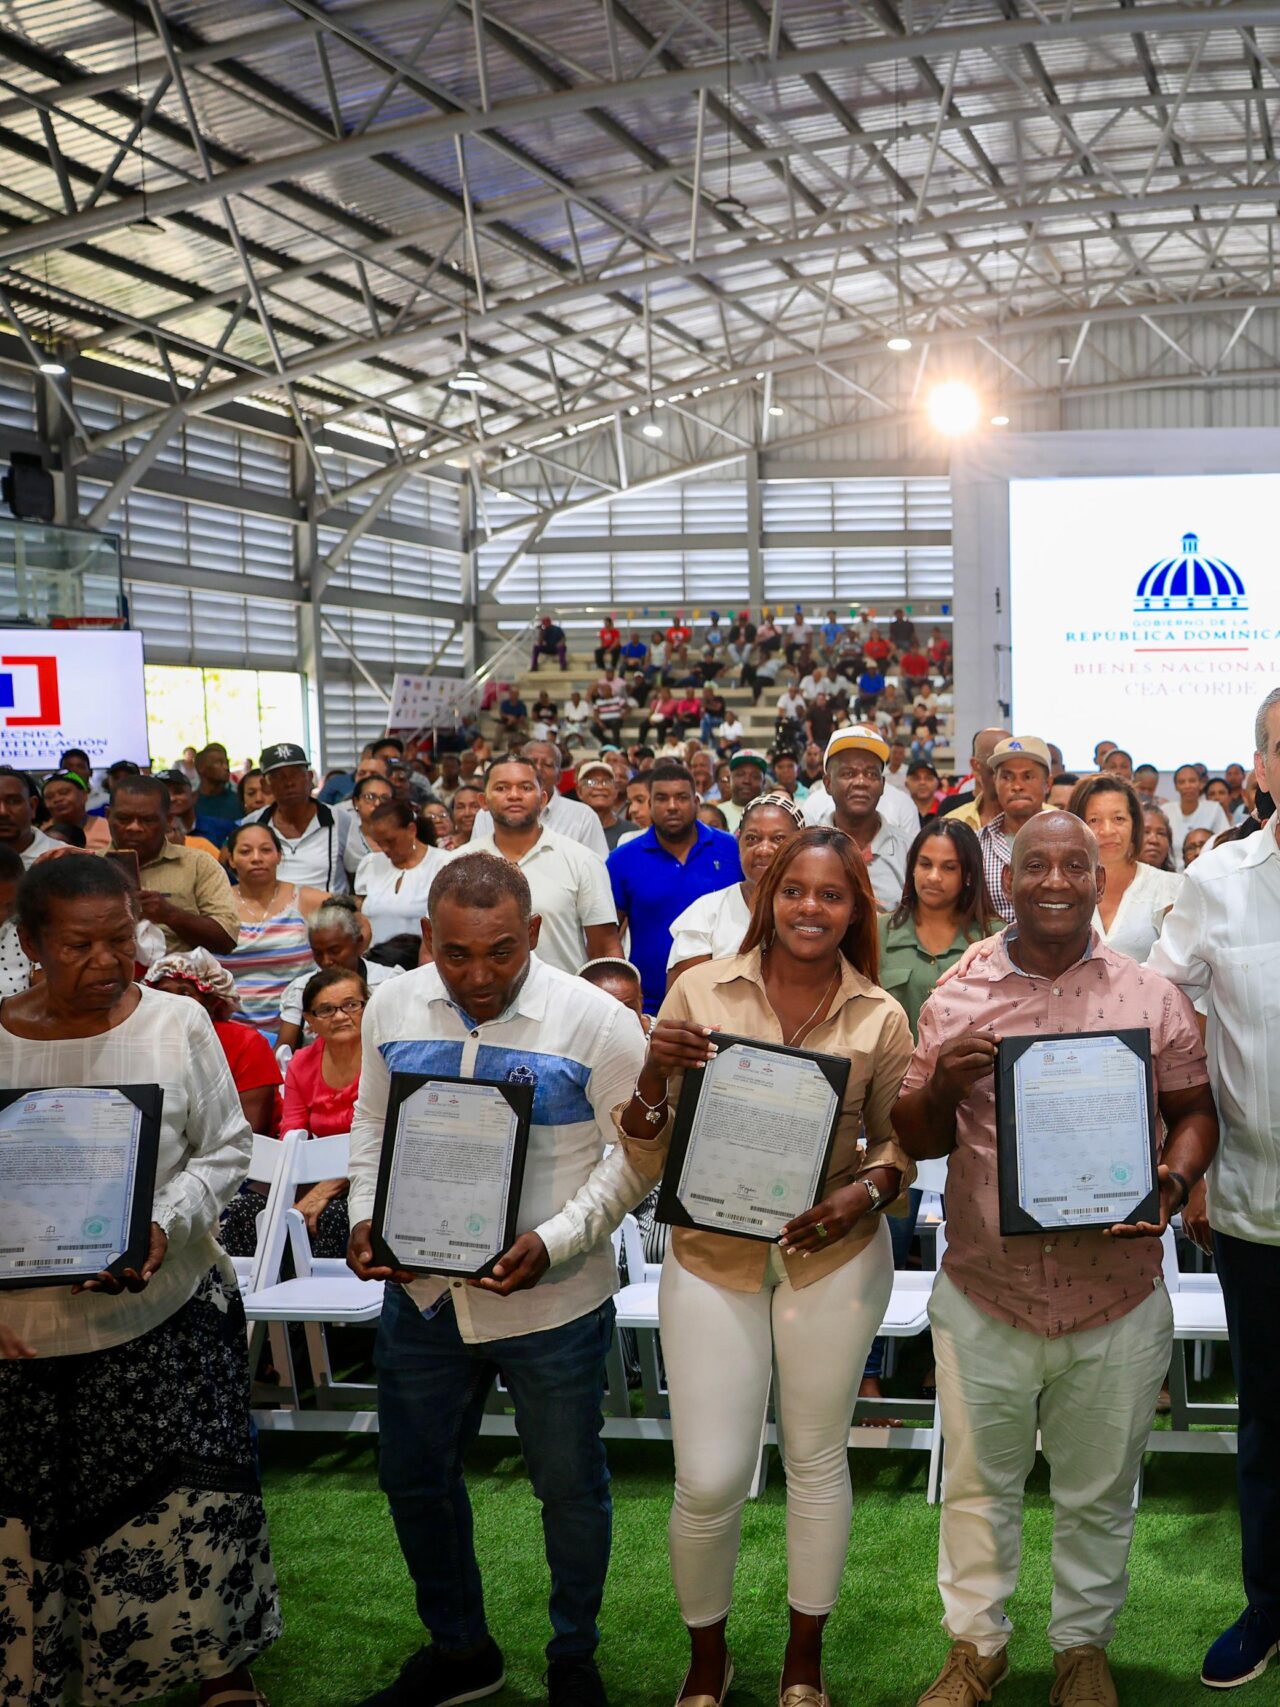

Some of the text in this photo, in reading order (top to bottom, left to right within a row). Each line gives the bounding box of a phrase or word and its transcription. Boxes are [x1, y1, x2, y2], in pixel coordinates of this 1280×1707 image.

[1133, 619, 1204, 627] GOBIERNO
[1065, 630, 1176, 642] REPÚBLICA
[1073, 661, 1153, 674] BIENES
[1125, 681, 1258, 697] CEA-CORDE
